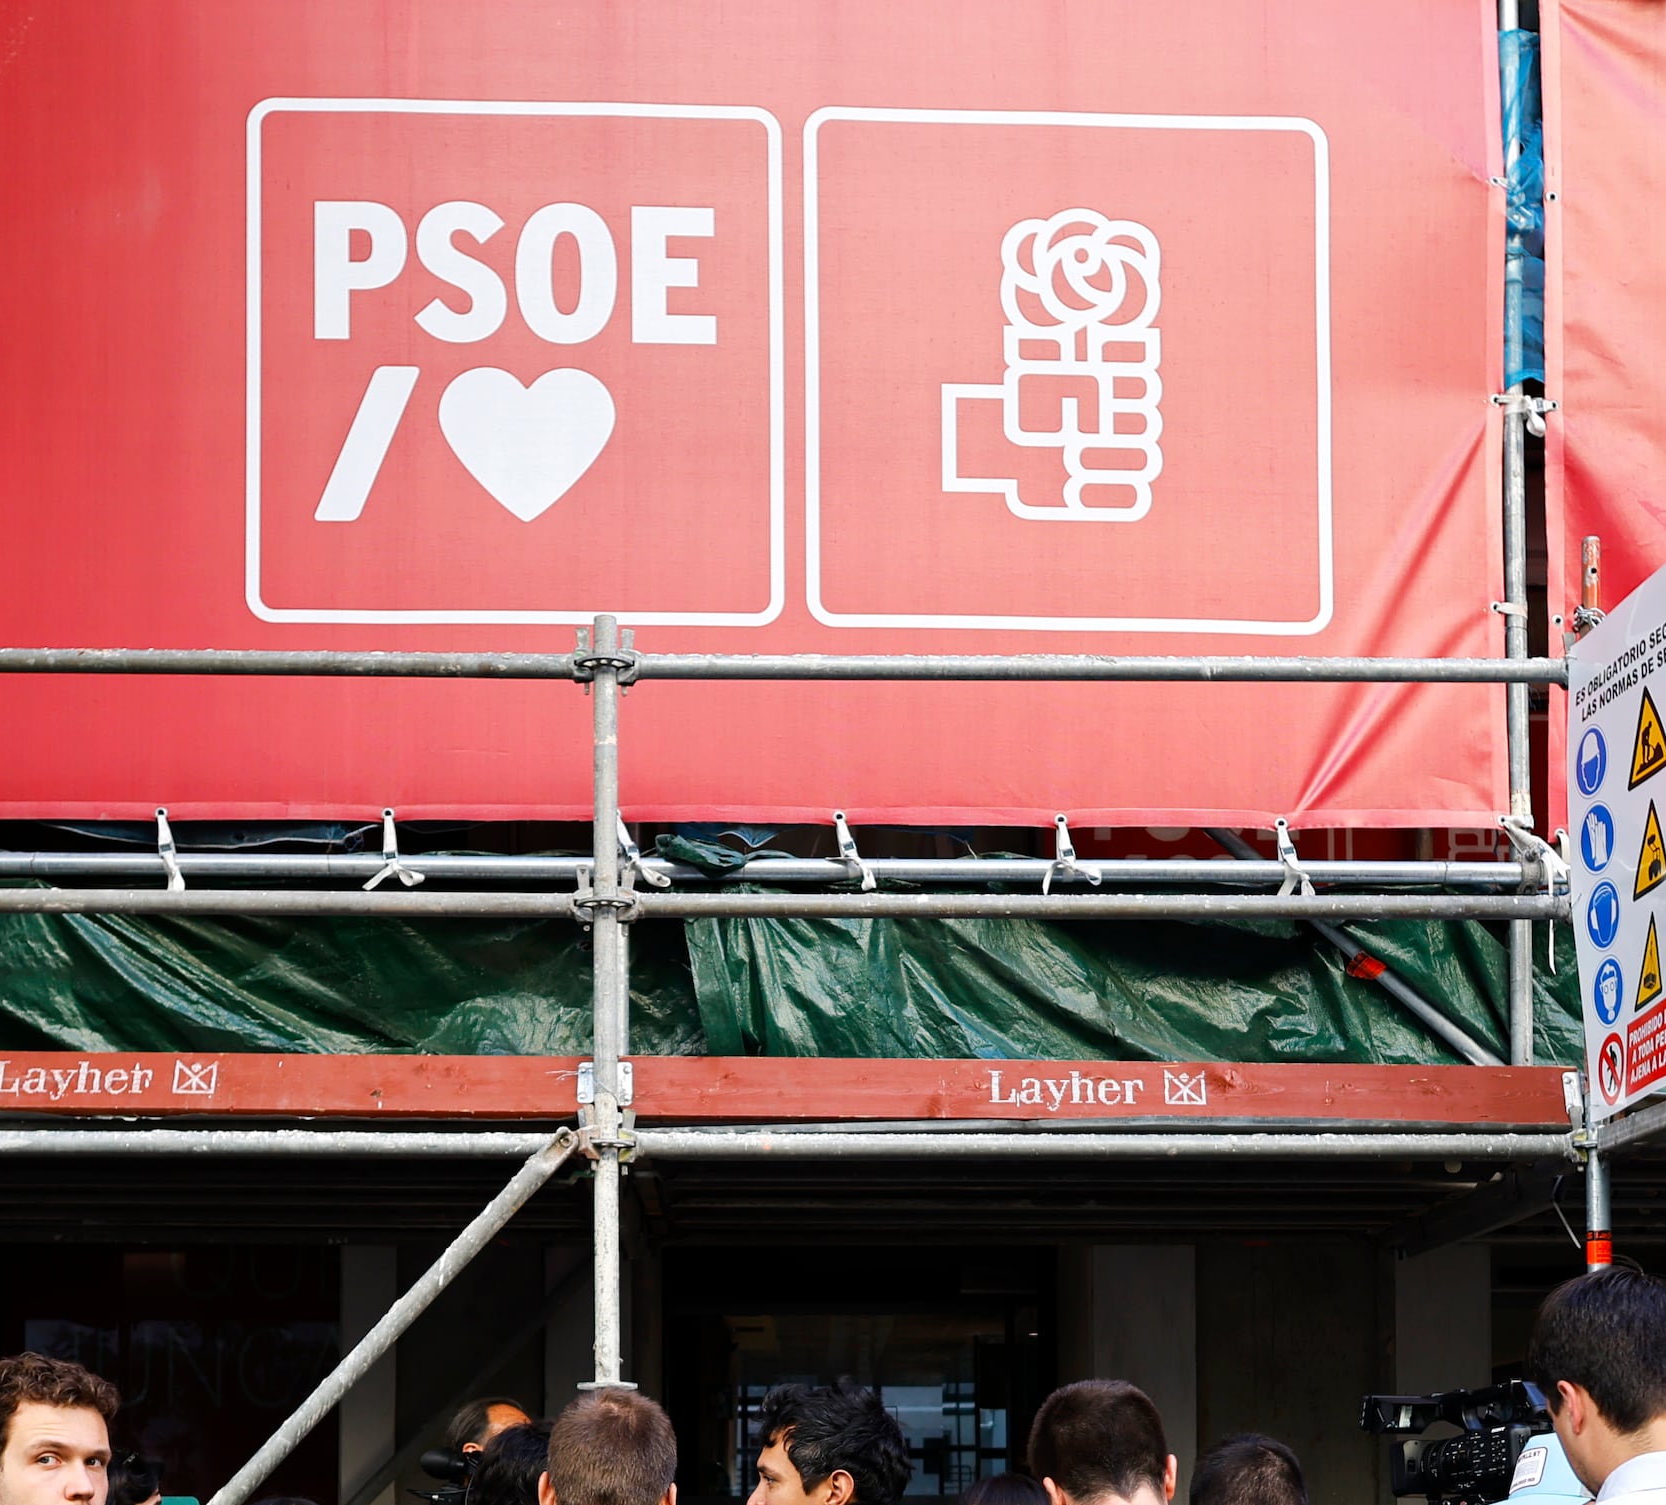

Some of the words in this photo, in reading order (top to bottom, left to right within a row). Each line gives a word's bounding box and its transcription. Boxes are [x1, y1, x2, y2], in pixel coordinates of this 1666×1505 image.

[313, 200, 717, 344] PSOE
[1576, 687, 1586, 706] ES
[1587, 639, 1646, 696] OBLIGATORIO
[1581, 699, 1597, 722] LAS
[1599, 669, 1638, 709] NORMAS
[1641, 657, 1654, 679] DE
[1629, 1012, 1662, 1048] PROHIBIDO
[1630, 1059, 1651, 1085] AJENA
[1652, 1056, 1657, 1072] A
[1632, 1049, 1637, 1065] A
[1638, 1037, 1654, 1060] TODA
[988, 1070, 1144, 1111] Layher
